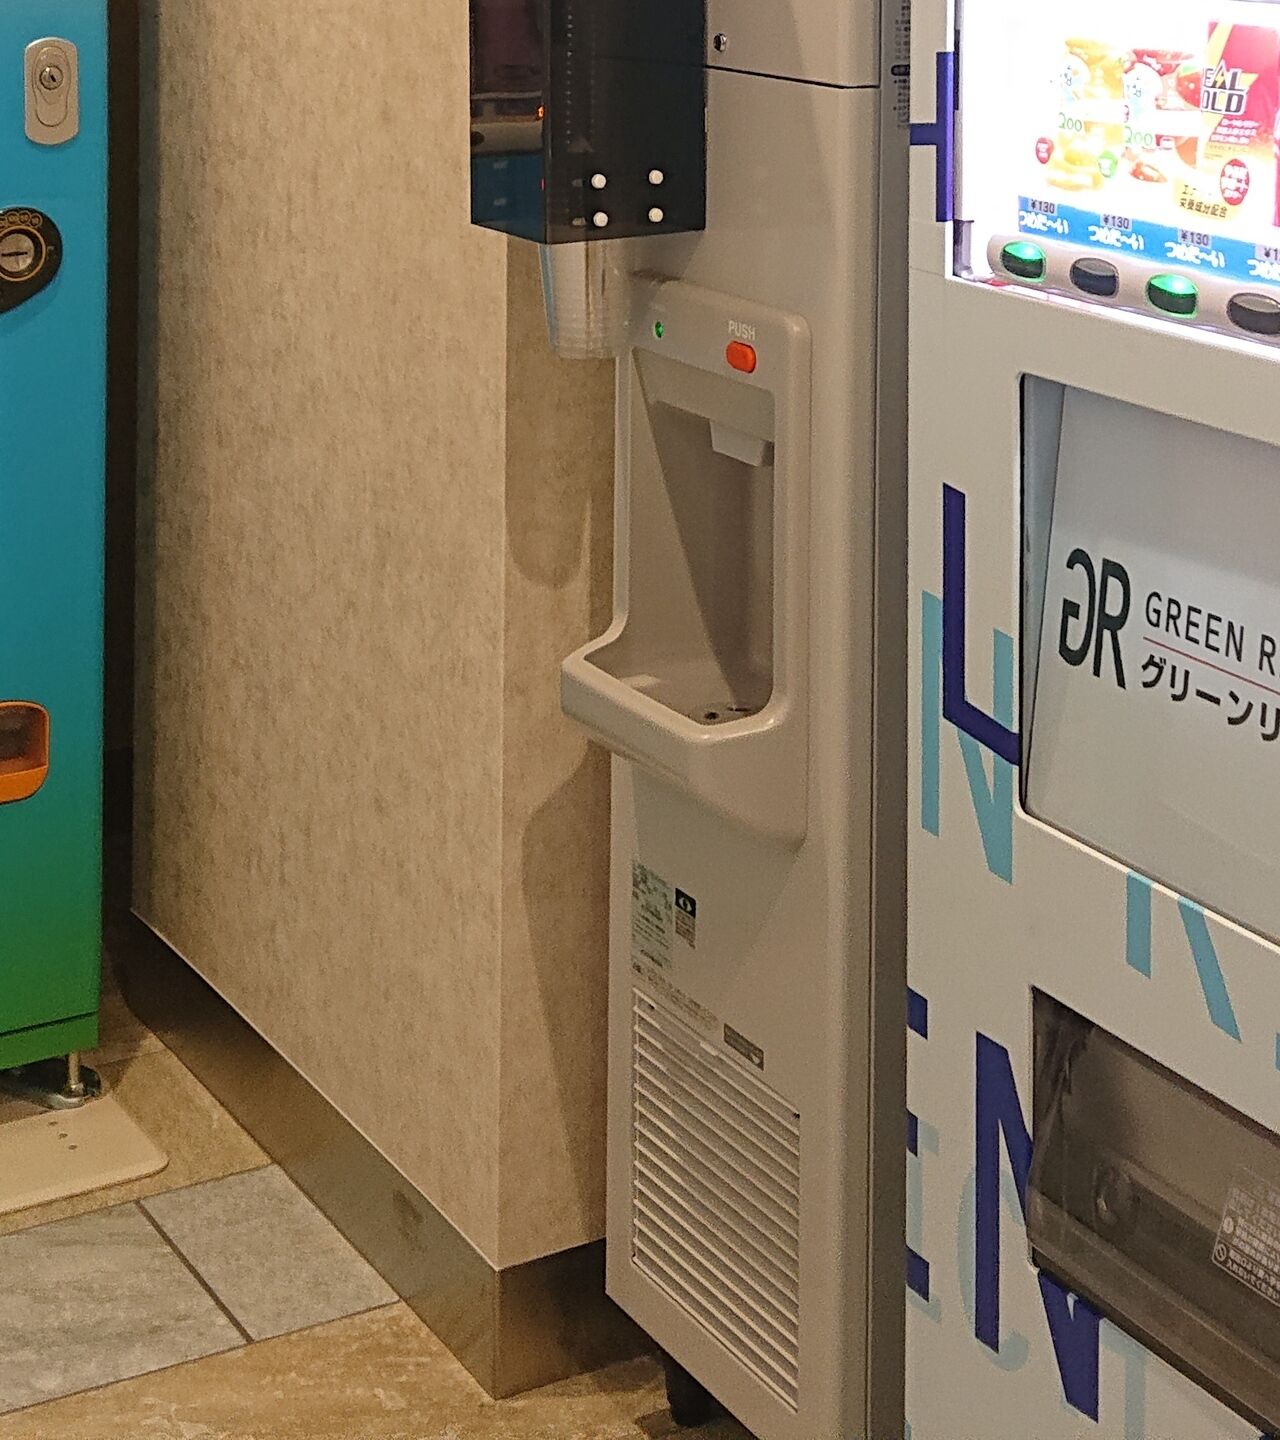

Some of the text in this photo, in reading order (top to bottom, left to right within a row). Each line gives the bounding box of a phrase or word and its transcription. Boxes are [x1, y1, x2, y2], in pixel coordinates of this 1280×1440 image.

[1030, 200, 1056, 214] ¥130
[1103, 214, 1131, 230] ¥130
[1181, 229, 1210, 246] ¥130
[727, 319, 757, 340] PUSH
[1144, 590, 1245, 663] GREEN
